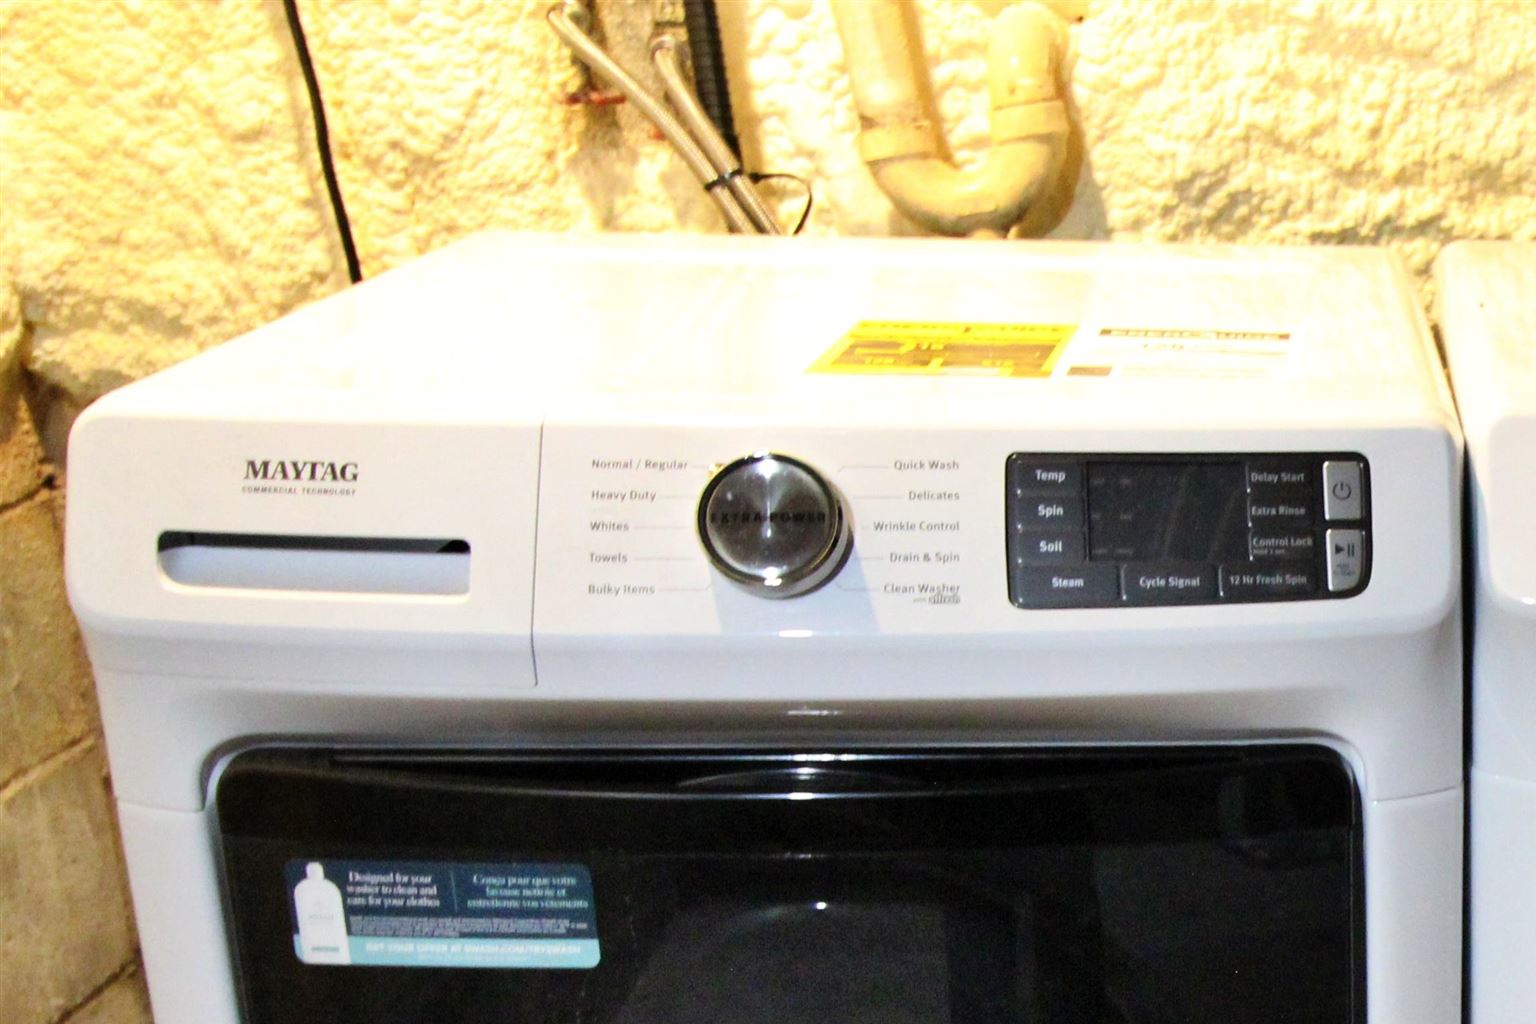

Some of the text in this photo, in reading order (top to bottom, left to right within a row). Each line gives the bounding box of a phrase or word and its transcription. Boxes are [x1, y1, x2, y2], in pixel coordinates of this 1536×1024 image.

[243, 459, 359, 482] MAYTAG
[591, 459, 633, 470] Normal
[644, 459, 688, 471] Regular
[893, 459, 960, 471] Quick Wash
[1035, 469, 1066, 483] Temp
[1250, 472, 1305, 484] Delay Start
[241, 485, 357, 497] COMMERCIAL TECHNOLOGY
[591, 490, 657, 502] Heavy Duty
[908, 490, 960, 500] Delicates
[1038, 504, 1064, 518] Spin
[1251, 506, 1306, 515] Extra Rinse
[590, 521, 630, 531] Whites
[873, 521, 960, 532] Wrinkle Control
[1039, 540, 1063, 552] Soil
[1252, 536, 1313, 546] Control Lock
[589, 553, 628, 563] Towels
[889, 552, 960, 565] Drain & Spin
[1051, 577, 1085, 588] Steam
[1139, 576, 1200, 590] Cycle Signal
[1229, 575, 1241, 585] 12
[1256, 574, 1282, 585] Fresh
[1285, 574, 1307, 587] Spin
[588, 583, 656, 597] Bulky Items
[883, 583, 961, 594] Clean Washer
[349, 871, 432, 885] Designed for your
[419, 885, 437, 896] and
